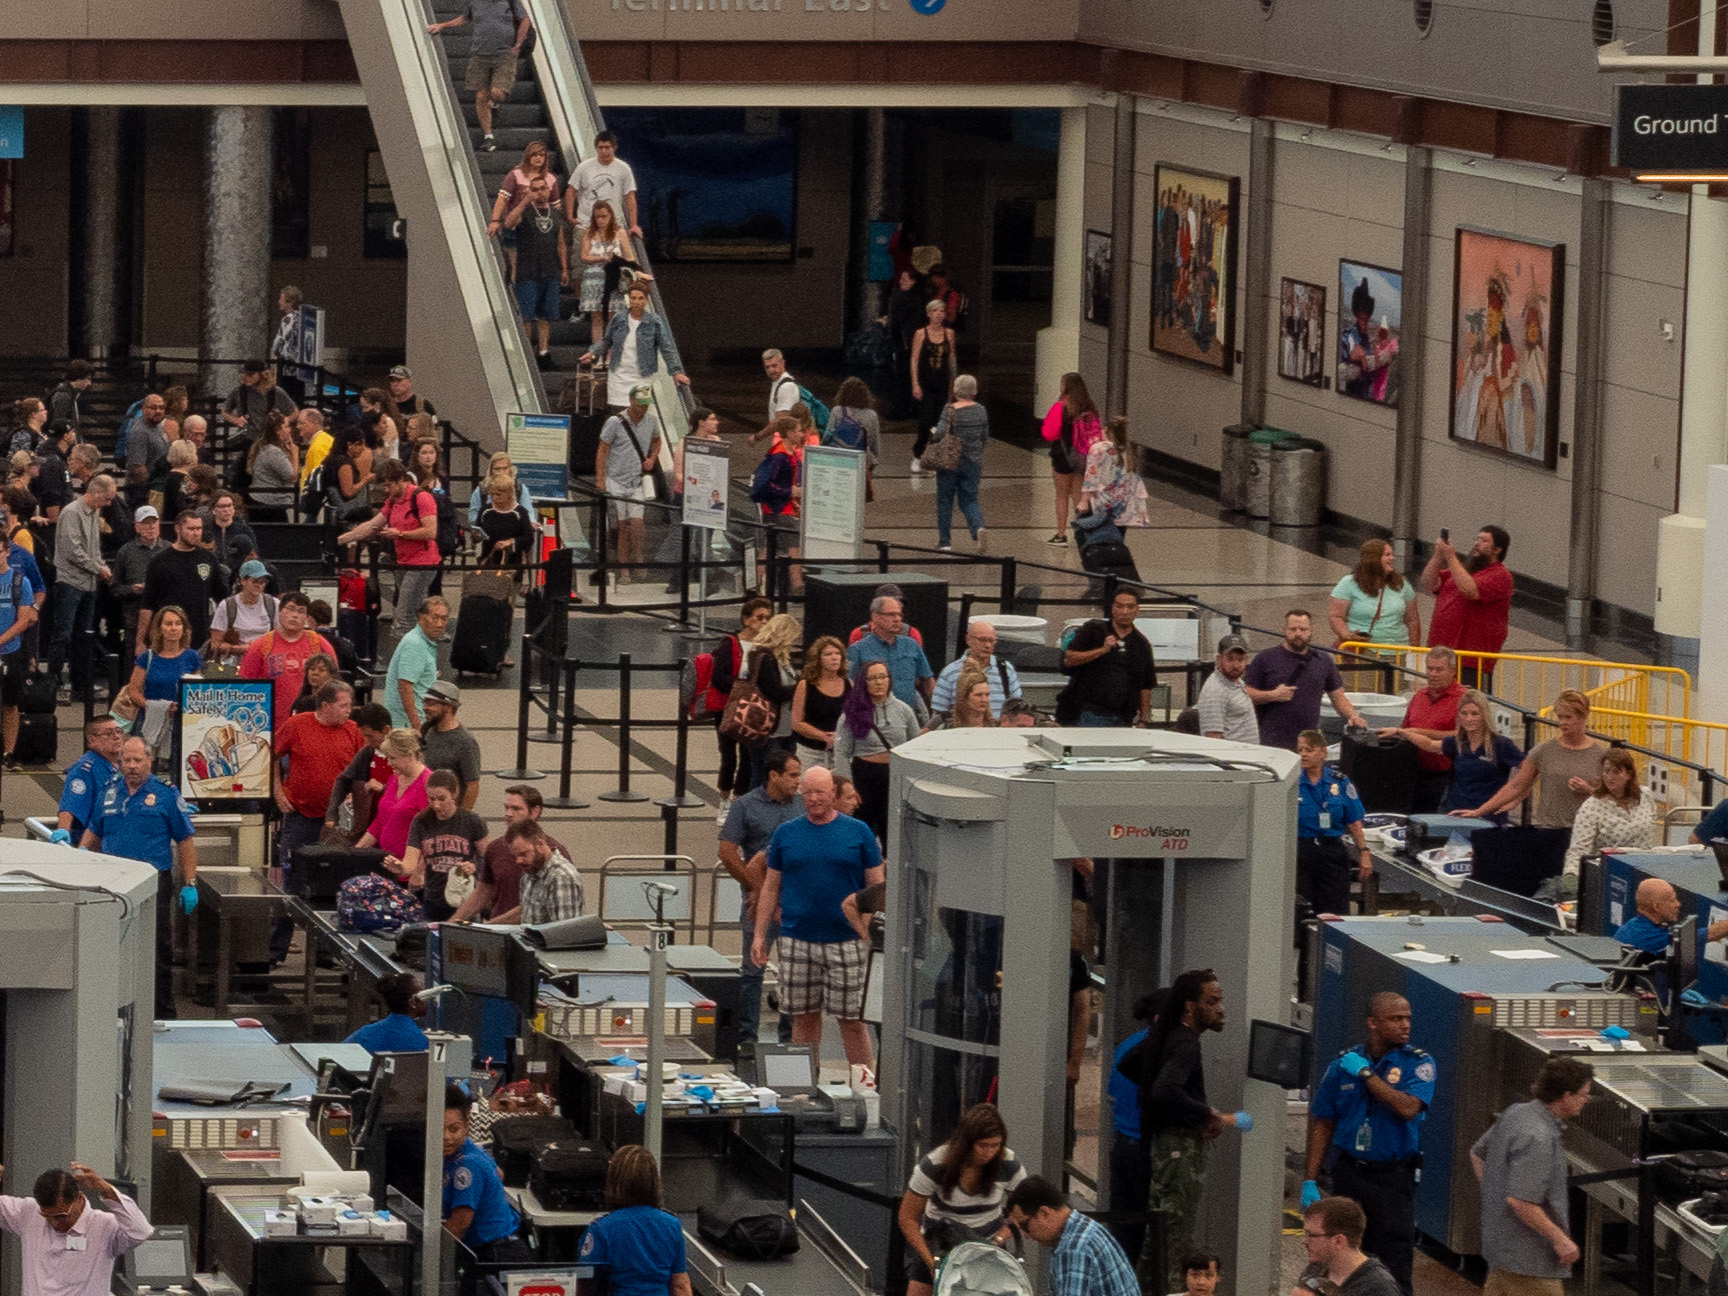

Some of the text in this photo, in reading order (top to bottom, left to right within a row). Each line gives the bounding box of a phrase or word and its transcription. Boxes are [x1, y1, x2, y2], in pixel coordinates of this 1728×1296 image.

[1634, 114, 1717, 136] Ground
[188, 690, 264, 701] Mail It Home
[1126, 826, 1190, 837] ProVision
[1161, 839, 1190, 850] ATD
[658, 933, 665, 950] 8
[437, 1043, 445, 1061] 7
